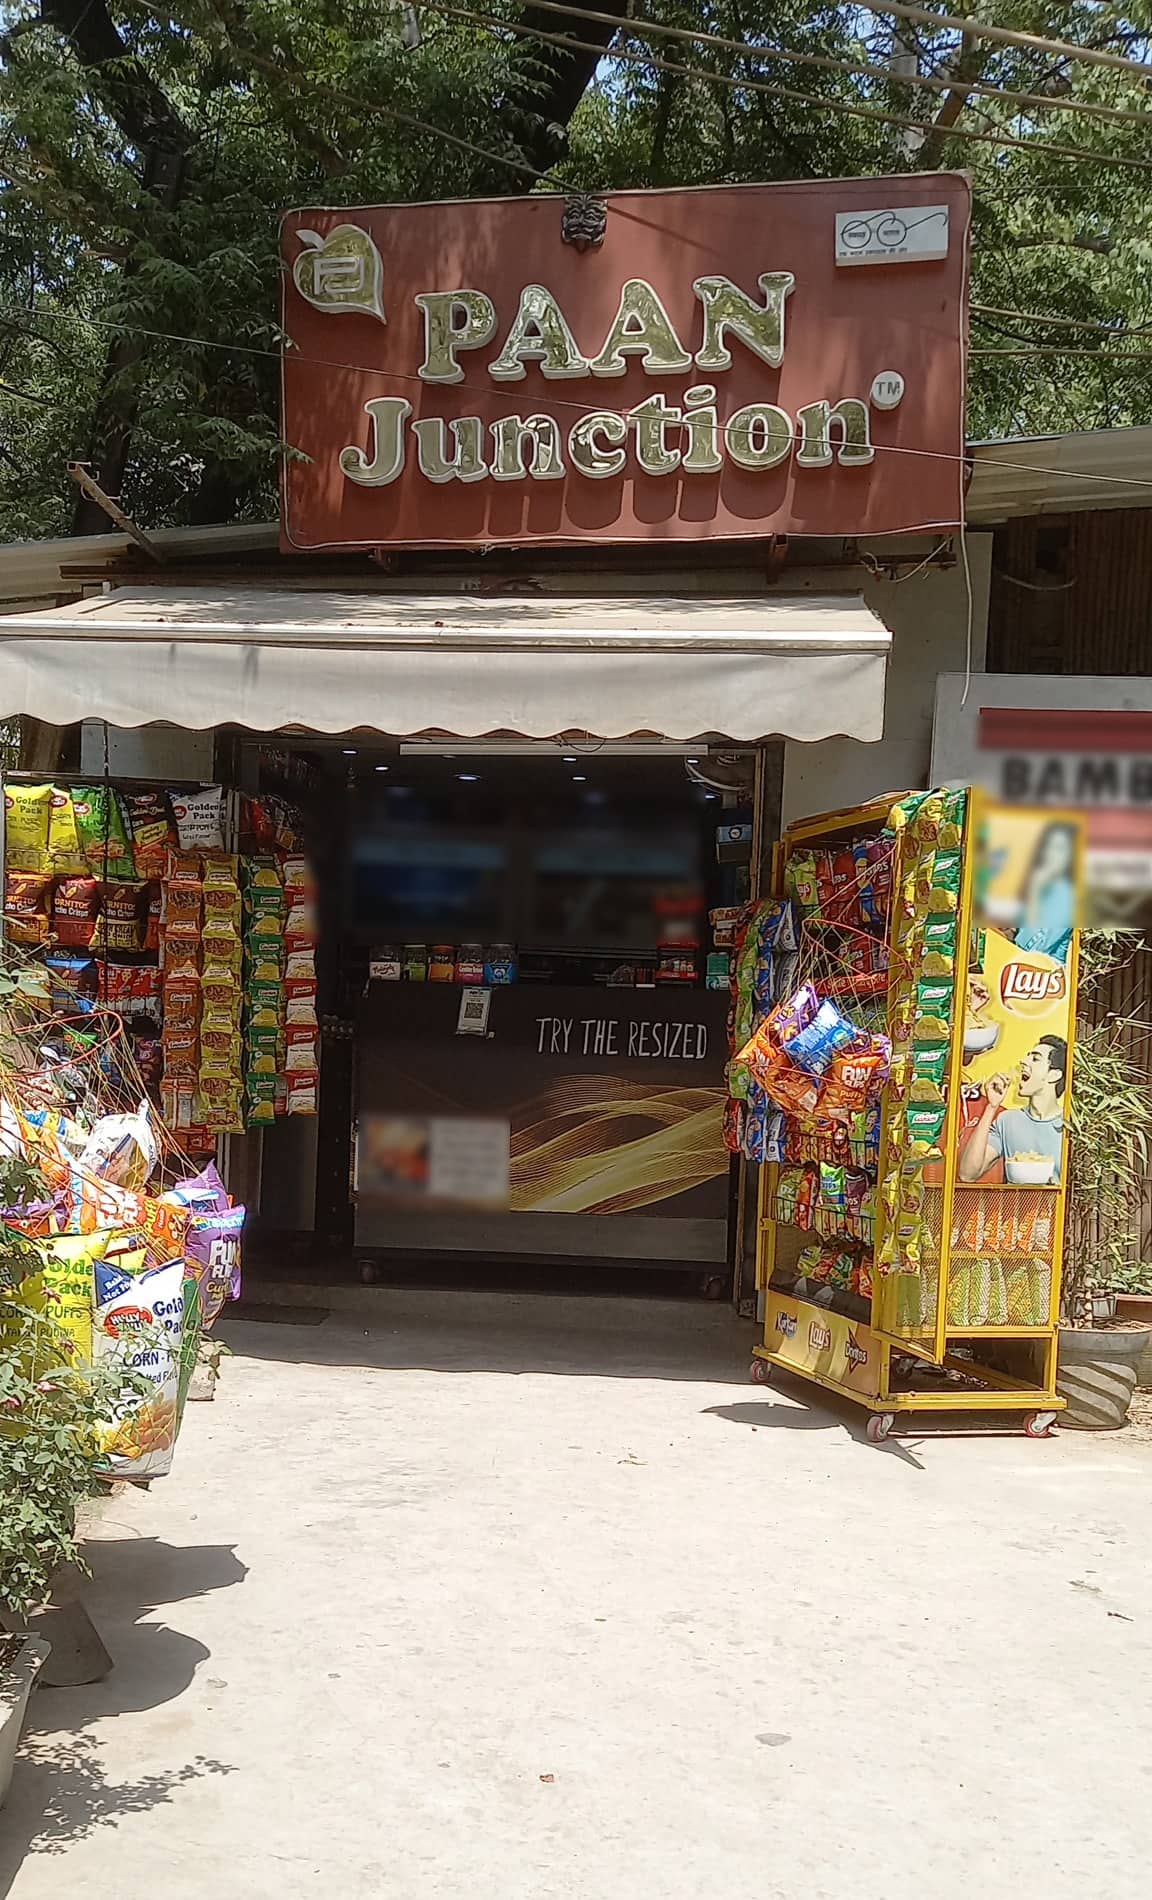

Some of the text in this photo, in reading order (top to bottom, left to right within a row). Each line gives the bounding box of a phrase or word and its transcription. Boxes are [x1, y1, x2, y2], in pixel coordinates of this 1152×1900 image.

[414, 271, 796, 384] PAAN
[874, 380, 901, 396] TM
[339, 384, 876, 487] Junction
[535, 1017, 707, 1059] TRY THE RESIZED
